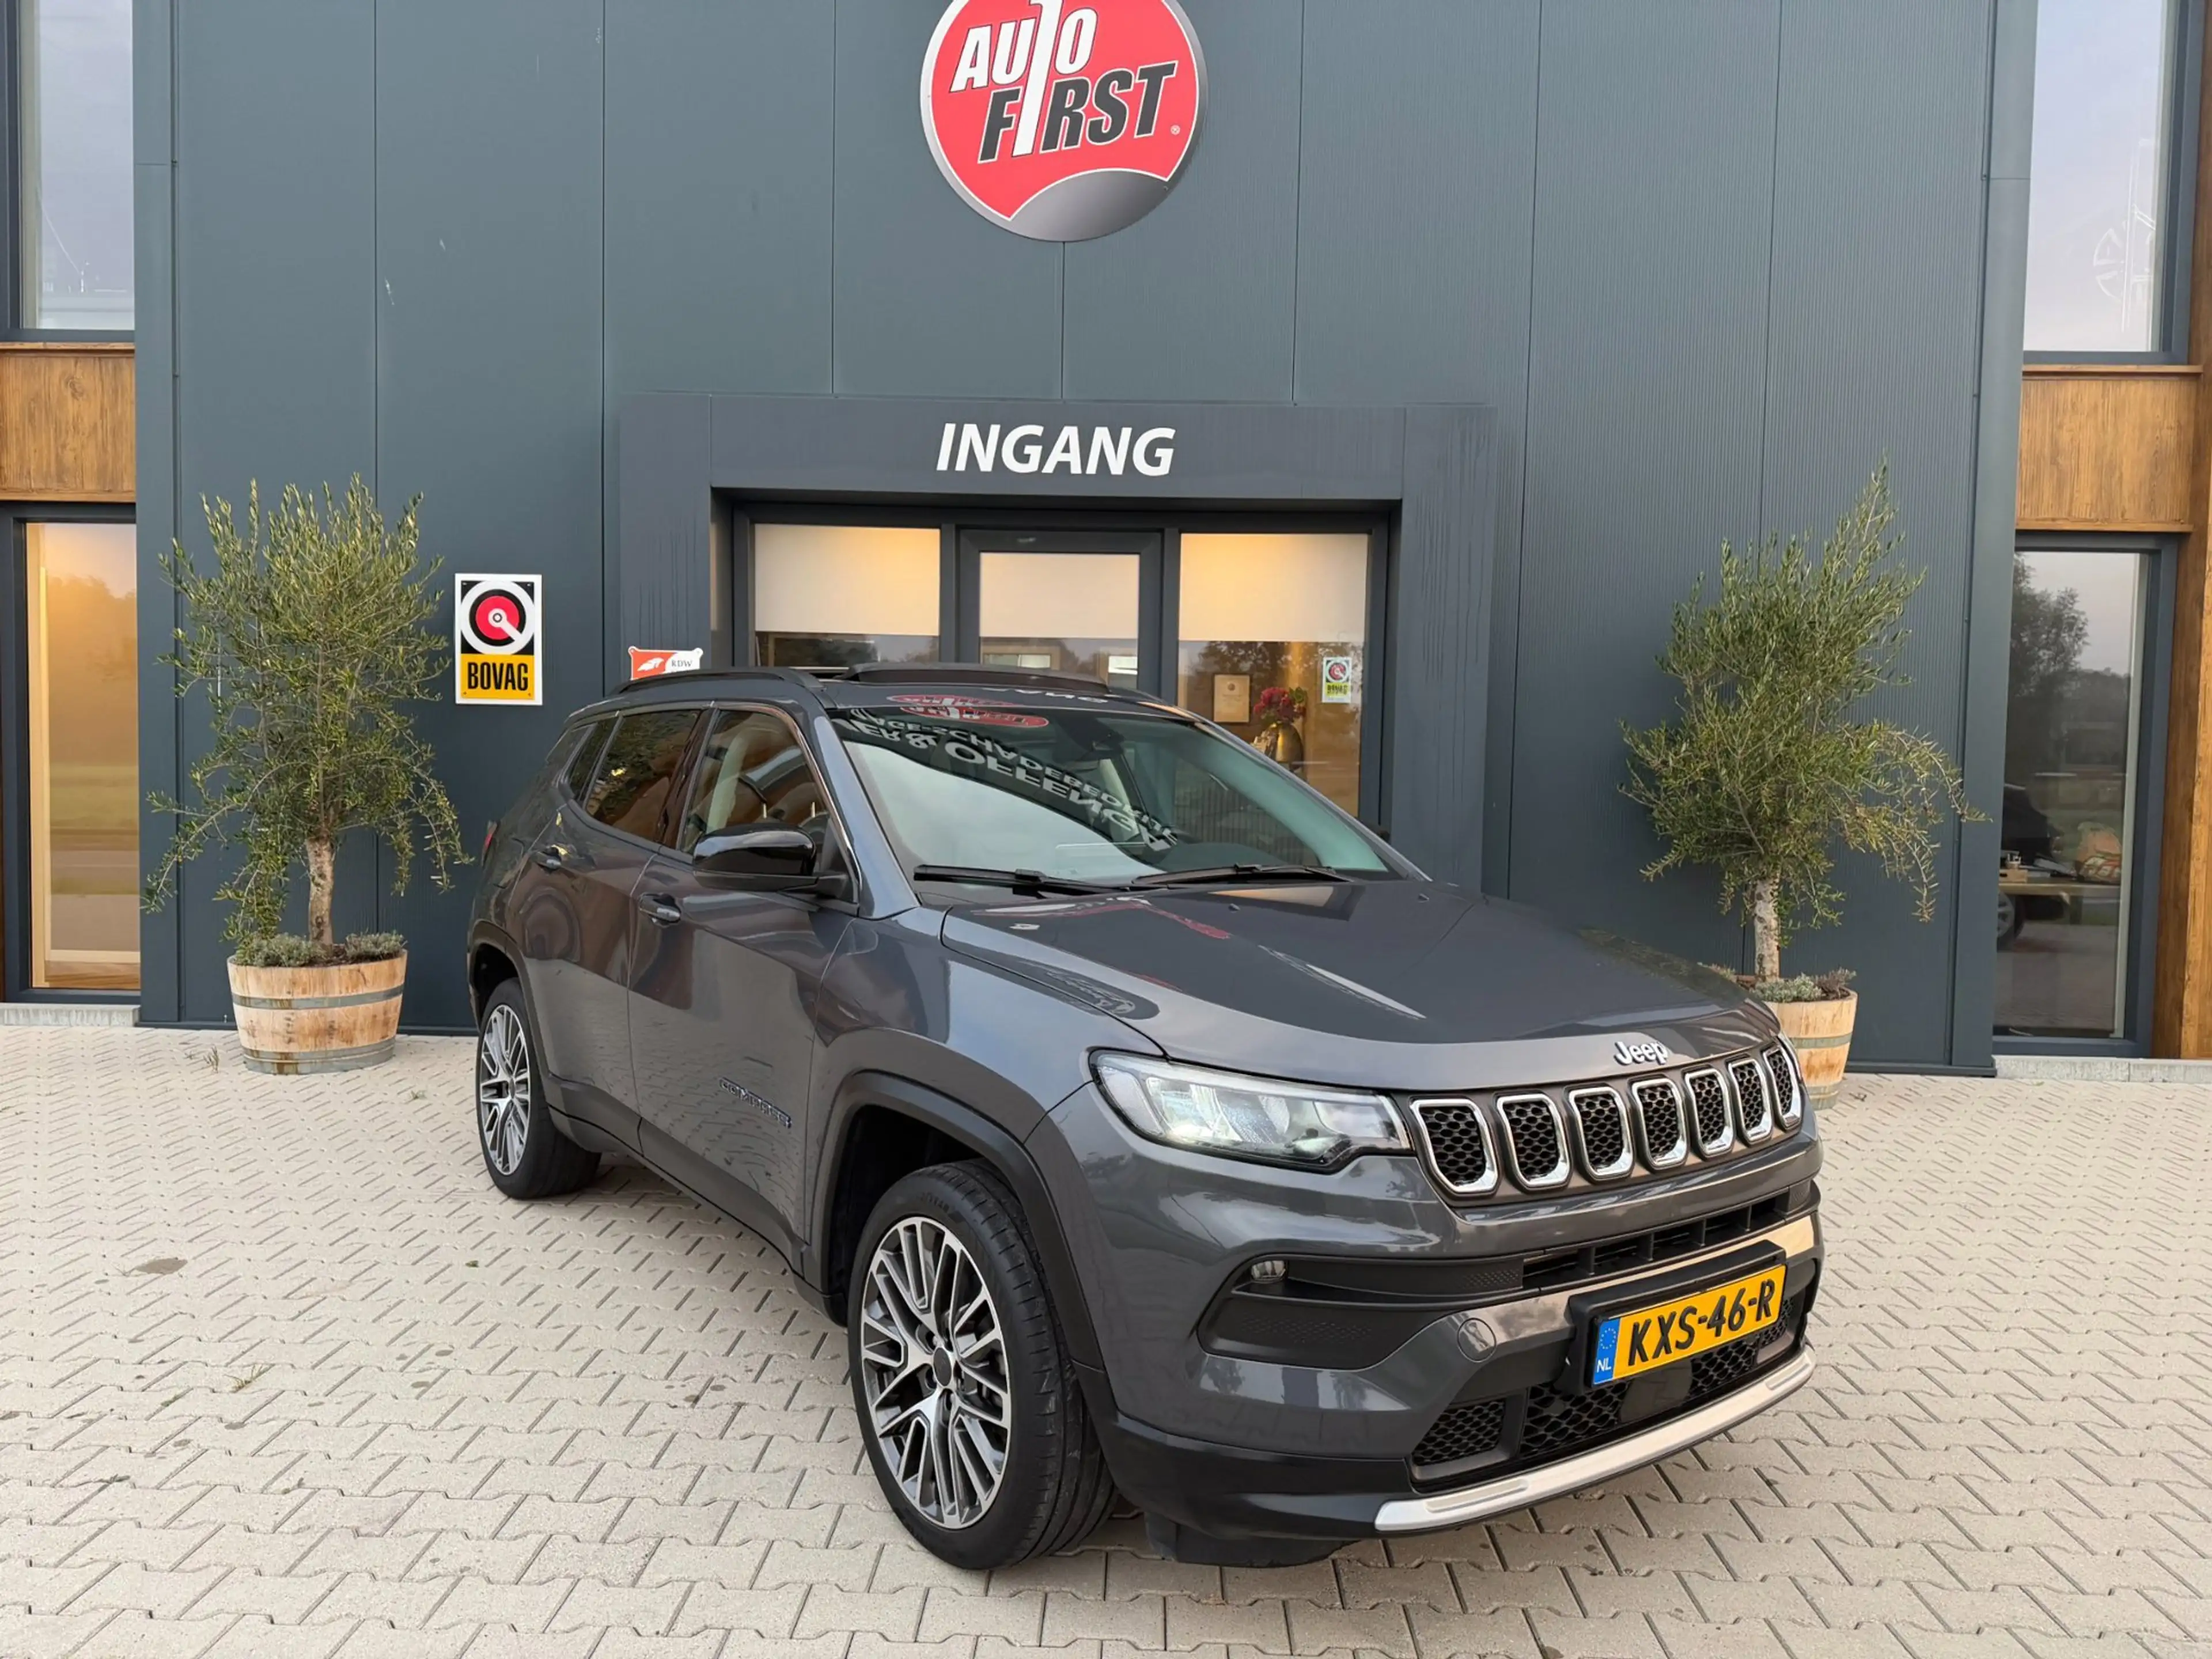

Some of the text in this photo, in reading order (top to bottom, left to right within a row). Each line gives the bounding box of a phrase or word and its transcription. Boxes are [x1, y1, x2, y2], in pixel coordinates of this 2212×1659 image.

[978, 60, 1179, 164] FIRST
[936, 423, 1176, 477] INGANG
[467, 662, 529, 691] BOVAG
[671, 660, 693, 668] RDW
[1613, 1041, 1668, 1066] Jeep
[1596, 1278, 1776, 1372] NL KXS-46-R
